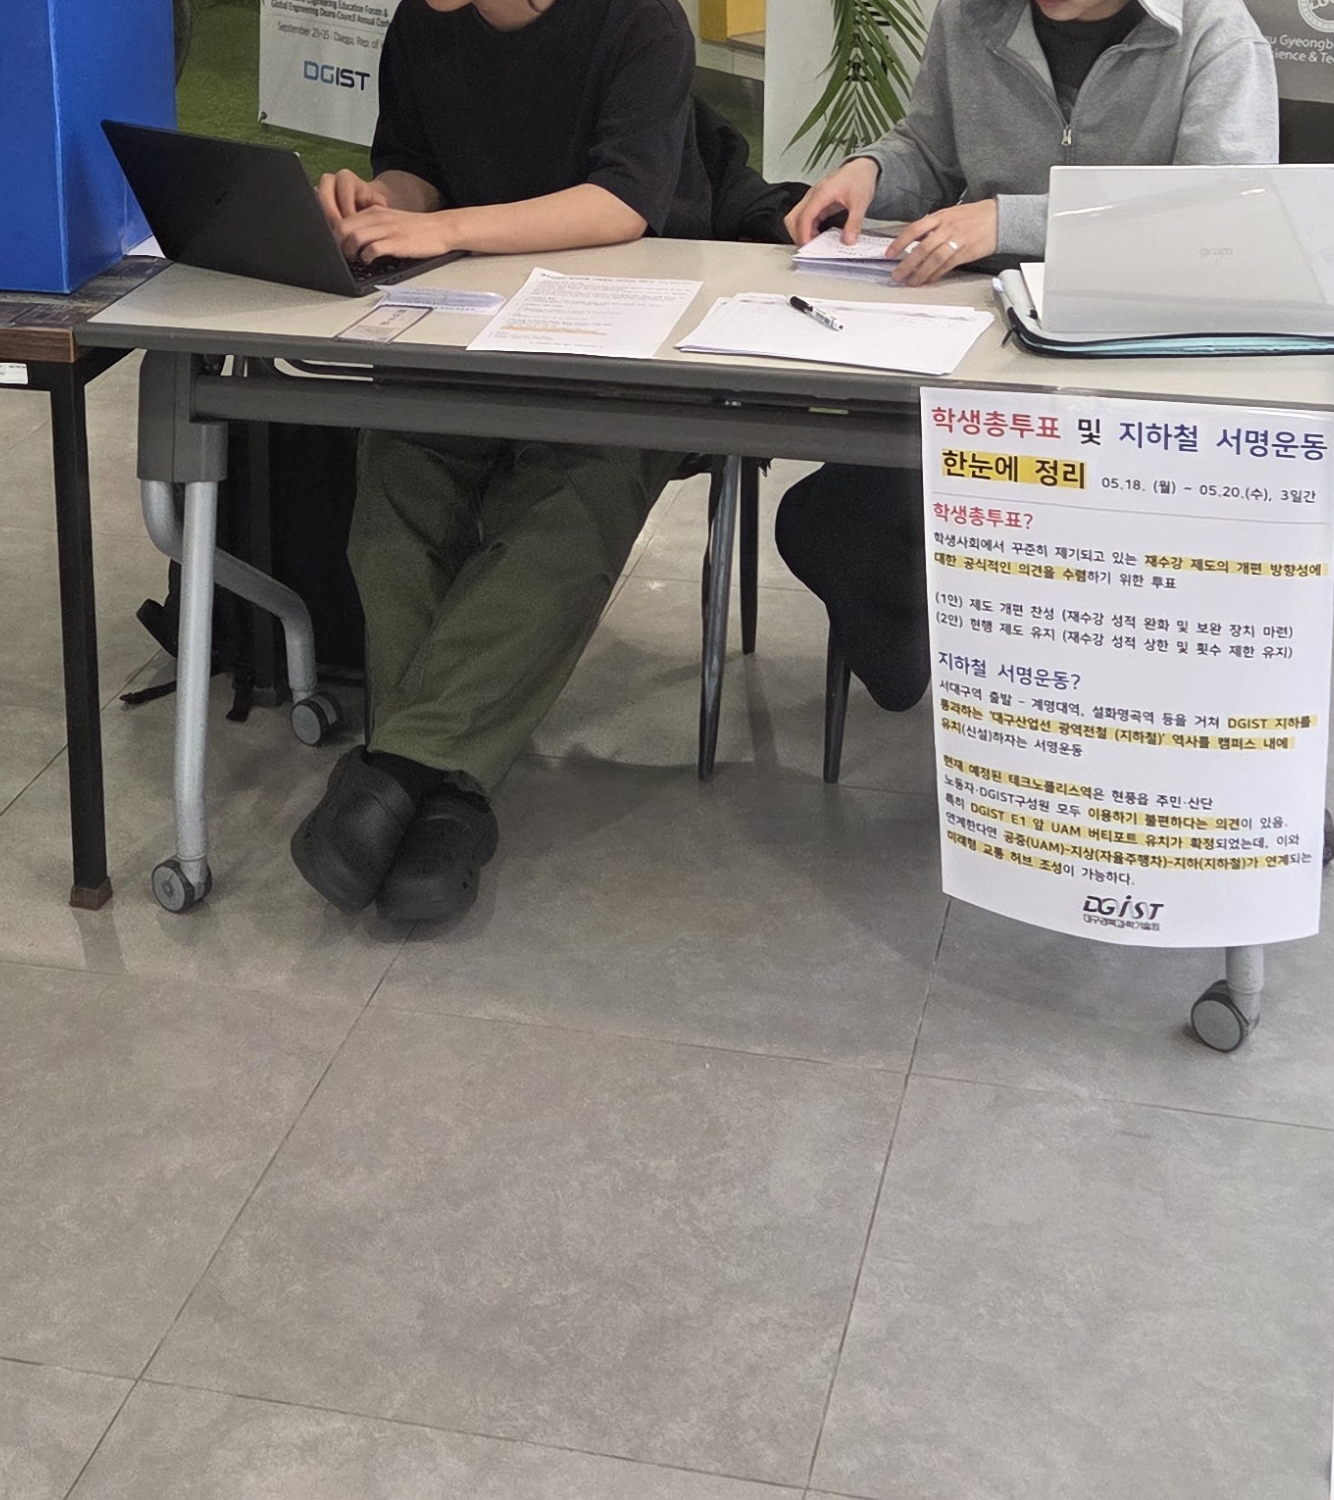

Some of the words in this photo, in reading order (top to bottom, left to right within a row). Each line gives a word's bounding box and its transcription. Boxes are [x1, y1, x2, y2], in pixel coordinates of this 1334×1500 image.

[304, 60, 370, 90] DGIST
[1308, 52, 1318, 63] &
[931, 406, 1061, 439] 학생총투표
[1078, 418, 1101, 446] 및
[1119, 421, 1199, 453] 지하철
[1216, 428, 1328, 461] 서명운동
[942, 450, 1018, 482] 한눈에
[1035, 459, 1085, 489] 정리
[1102, 477, 1145, 492] 05.18.
[1153, 479, 1176, 495] (월)
[1280, 489, 1317, 504] 3일간
[932, 502, 1033, 531] 학생총투표?
[933, 531, 1005, 552] 학생사회에서
[1011, 541, 1048, 558] 꾸준히
[1054, 545, 1105, 564] 제기되고
[1112, 551, 1137, 566] 있는
[1144, 553, 1183, 571] 재수강
[1190, 557, 1229, 574] 제도의
[1236, 561, 1263, 576] 개편
[1270, 563, 1322, 578] 방향성에
[934, 551, 957, 568] 대한
[963, 556, 1012, 576] 공식적인
[1019, 563, 1055, 580] 의견을
[1119, 572, 1144, 588] 위한
[1151, 575, 1177, 590] 투표
[969, 598, 993, 613] 제도
[1000, 602, 1024, 618] 개편
[1030, 605, 1055, 621] 찬성
[1062, 608, 1104, 626] (재수강
[1111, 614, 1136, 629] 성적
[1143, 616, 1169, 632] 완화
[1196, 622, 1222, 636] 보완
[1229, 624, 1255, 639] 장치
[1263, 625, 1294, 640] 마련)
[999, 622, 1024, 637] 제도
[1030, 626, 1056, 642] 유지
[1062, 629, 1104, 647] (재수강
[1111, 635, 1136, 650] 성적
[1143, 638, 1169, 653] 상한
[1229, 644, 1255, 659] 제한
[1262, 646, 1294, 660] 유지)
[938, 651, 987, 679] 지하철
[997, 663, 1081, 691] 서명운동?
[939, 679, 983, 701] 서대구역
[988, 690, 1013, 707] 출발
[1092, 705, 1154, 725] 설화명곡역
[1162, 712, 1187, 727] 등을
[1194, 715, 1220, 730] 거쳐
[1227, 717, 1268, 730] DGIST
[1274, 715, 1312, 730] 지하를
[940, 698, 984, 722] 통과하는
[1058, 721, 1108, 741] 광역전철
[1172, 733, 1210, 750] 역사를
[1263, 736, 1290, 750] 내에
[941, 716, 1028, 750] 유치(신설)하자는
[1034, 738, 1084, 758] 서명운동
[943, 754, 964, 773] 현재
[968, 763, 1003, 784] 예정된
[945, 792, 965, 811] 특히
[970, 802, 1005, 822] DGIST
[1011, 812, 1027, 827] E1
[1051, 821, 1081, 838] UAM
[1088, 827, 1138, 846] 버티포트
[1145, 834, 1183, 850] 유치가
[1276, 833, 1300, 848] 이와
[1056, 802, 1081, 818] 모두
[1088, 806, 1137, 826] 이용하기
[1145, 813, 1208, 830] 불편하다는
[1215, 816, 1253, 831] 의견이
[945, 811, 997, 840] 연계한다면
[1265, 852, 1312, 868] 연계되는
[1010, 850, 1033, 867] 허브
[1040, 858, 1075, 878] 조성이
[1082, 867, 1135, 887] 가능하다.
